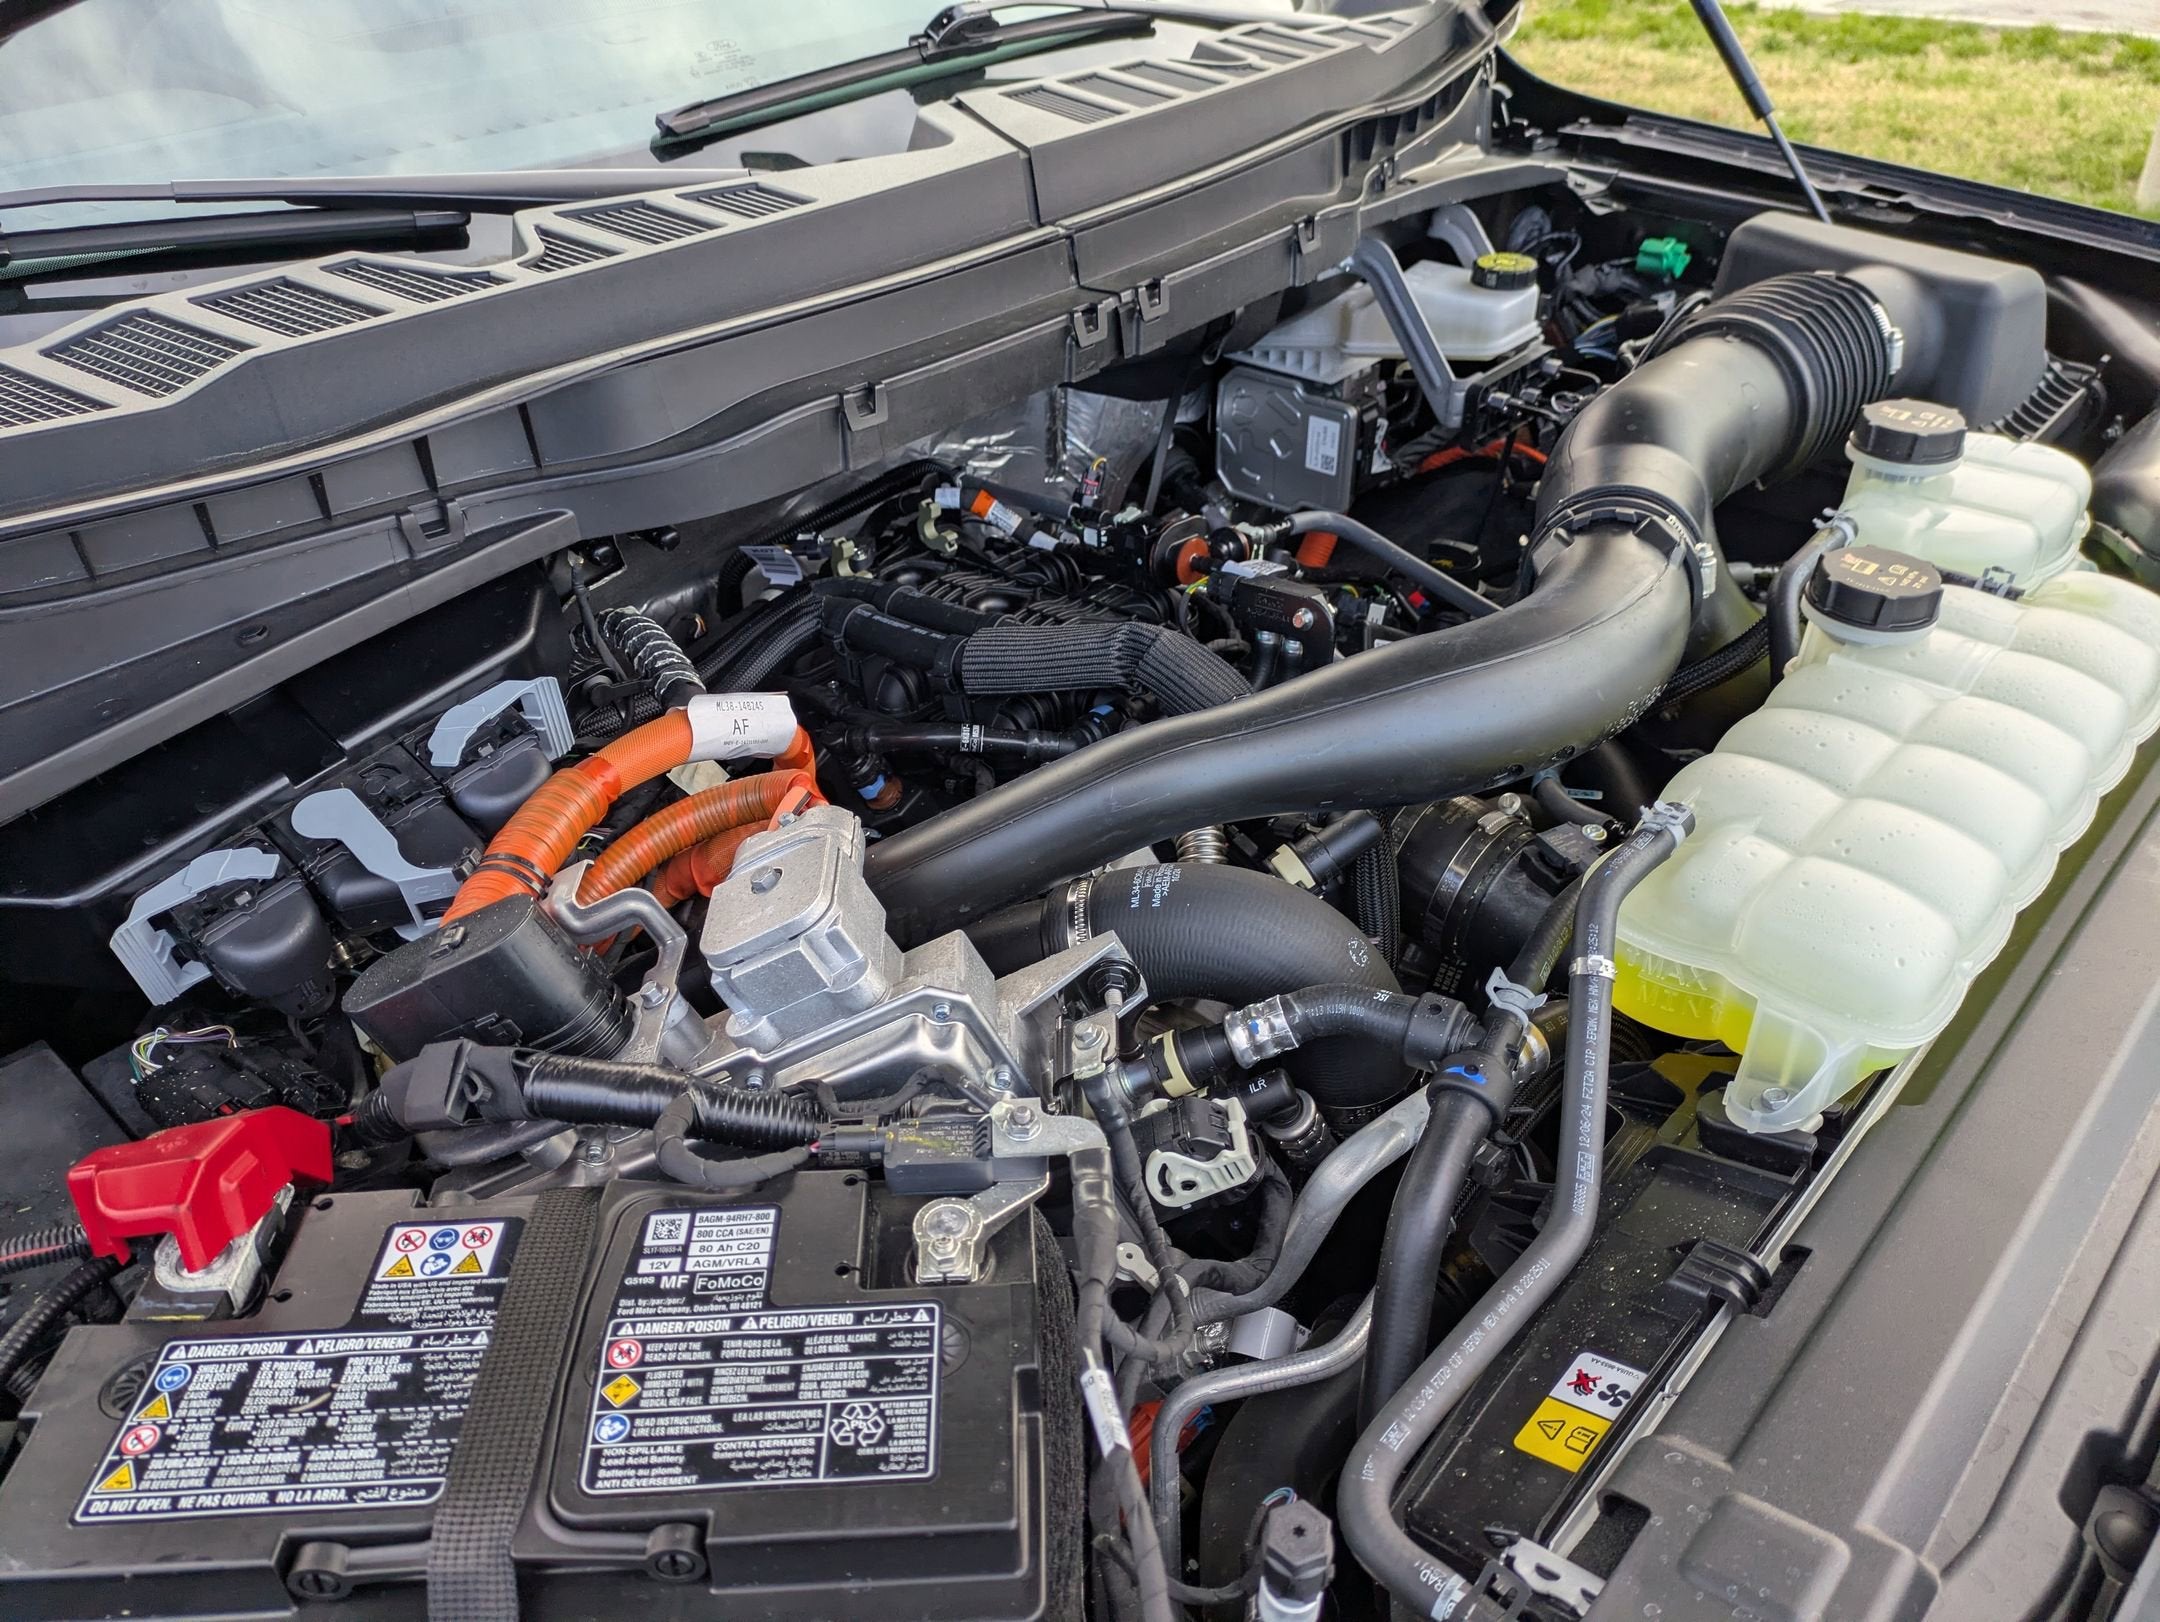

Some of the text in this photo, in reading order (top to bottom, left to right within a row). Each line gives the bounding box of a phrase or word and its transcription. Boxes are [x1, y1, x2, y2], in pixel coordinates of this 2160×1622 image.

[732, 719, 749, 735] AF
[699, 1212, 771, 1224] BAGM-94RH7-800
[697, 1227, 769, 1238] 800 CCA (SAE/EN)
[699, 1242, 760, 1253] 80 Ah C20
[650, 1261, 672, 1270] 12V
[692, 1257, 761, 1269] AGM/VRLA
[660, 1275, 690, 1289] MF
[697, 1275, 763, 1290] FoMoCo
[635, 1306, 656, 1315] Motor
[635, 1319, 731, 1334] DANGER/POISON
[759, 1313, 853, 1329] PELIGRO/VENENO
[847, 1333, 877, 1343] ALCANCE
[187, 1342, 288, 1358] DANGER/POISON
[315, 1336, 413, 1353] PELIGRO/VENENO
[678, 1342, 688, 1351] OF
[644, 1353, 666, 1362] REACH
[196, 1364, 225, 1373] SHIELD
[315, 1368, 333, 1377] GAZ
[386, 1363, 412, 1373] GASES
[192, 1373, 238, 1382] EXPLOSIVE
[252, 1378, 331, 1388] EXPLOSIFS PEUVENT
[188, 1381, 232, 1391] GASES CAN
[733, 1412, 747, 1422] LEA
[748, 1412, 763, 1421] LAS
[632, 1428, 650, 1437] LIRE
[651, 1427, 665, 1436] LES
[714, 1438, 816, 1450] CONTRA DERRAMES
[602, 1445, 684, 1456] NON-SPILLABLE
[600, 1455, 686, 1467] Lead Acid Battery
[597, 1468, 636, 1478] Batterie
[651, 1466, 682, 1477] plomb
[595, 1479, 620, 1488] ANTI
[90, 1488, 348, 1514] DO NOT OPEN. NE PAS OUVRIR. NO LA ABRA.
